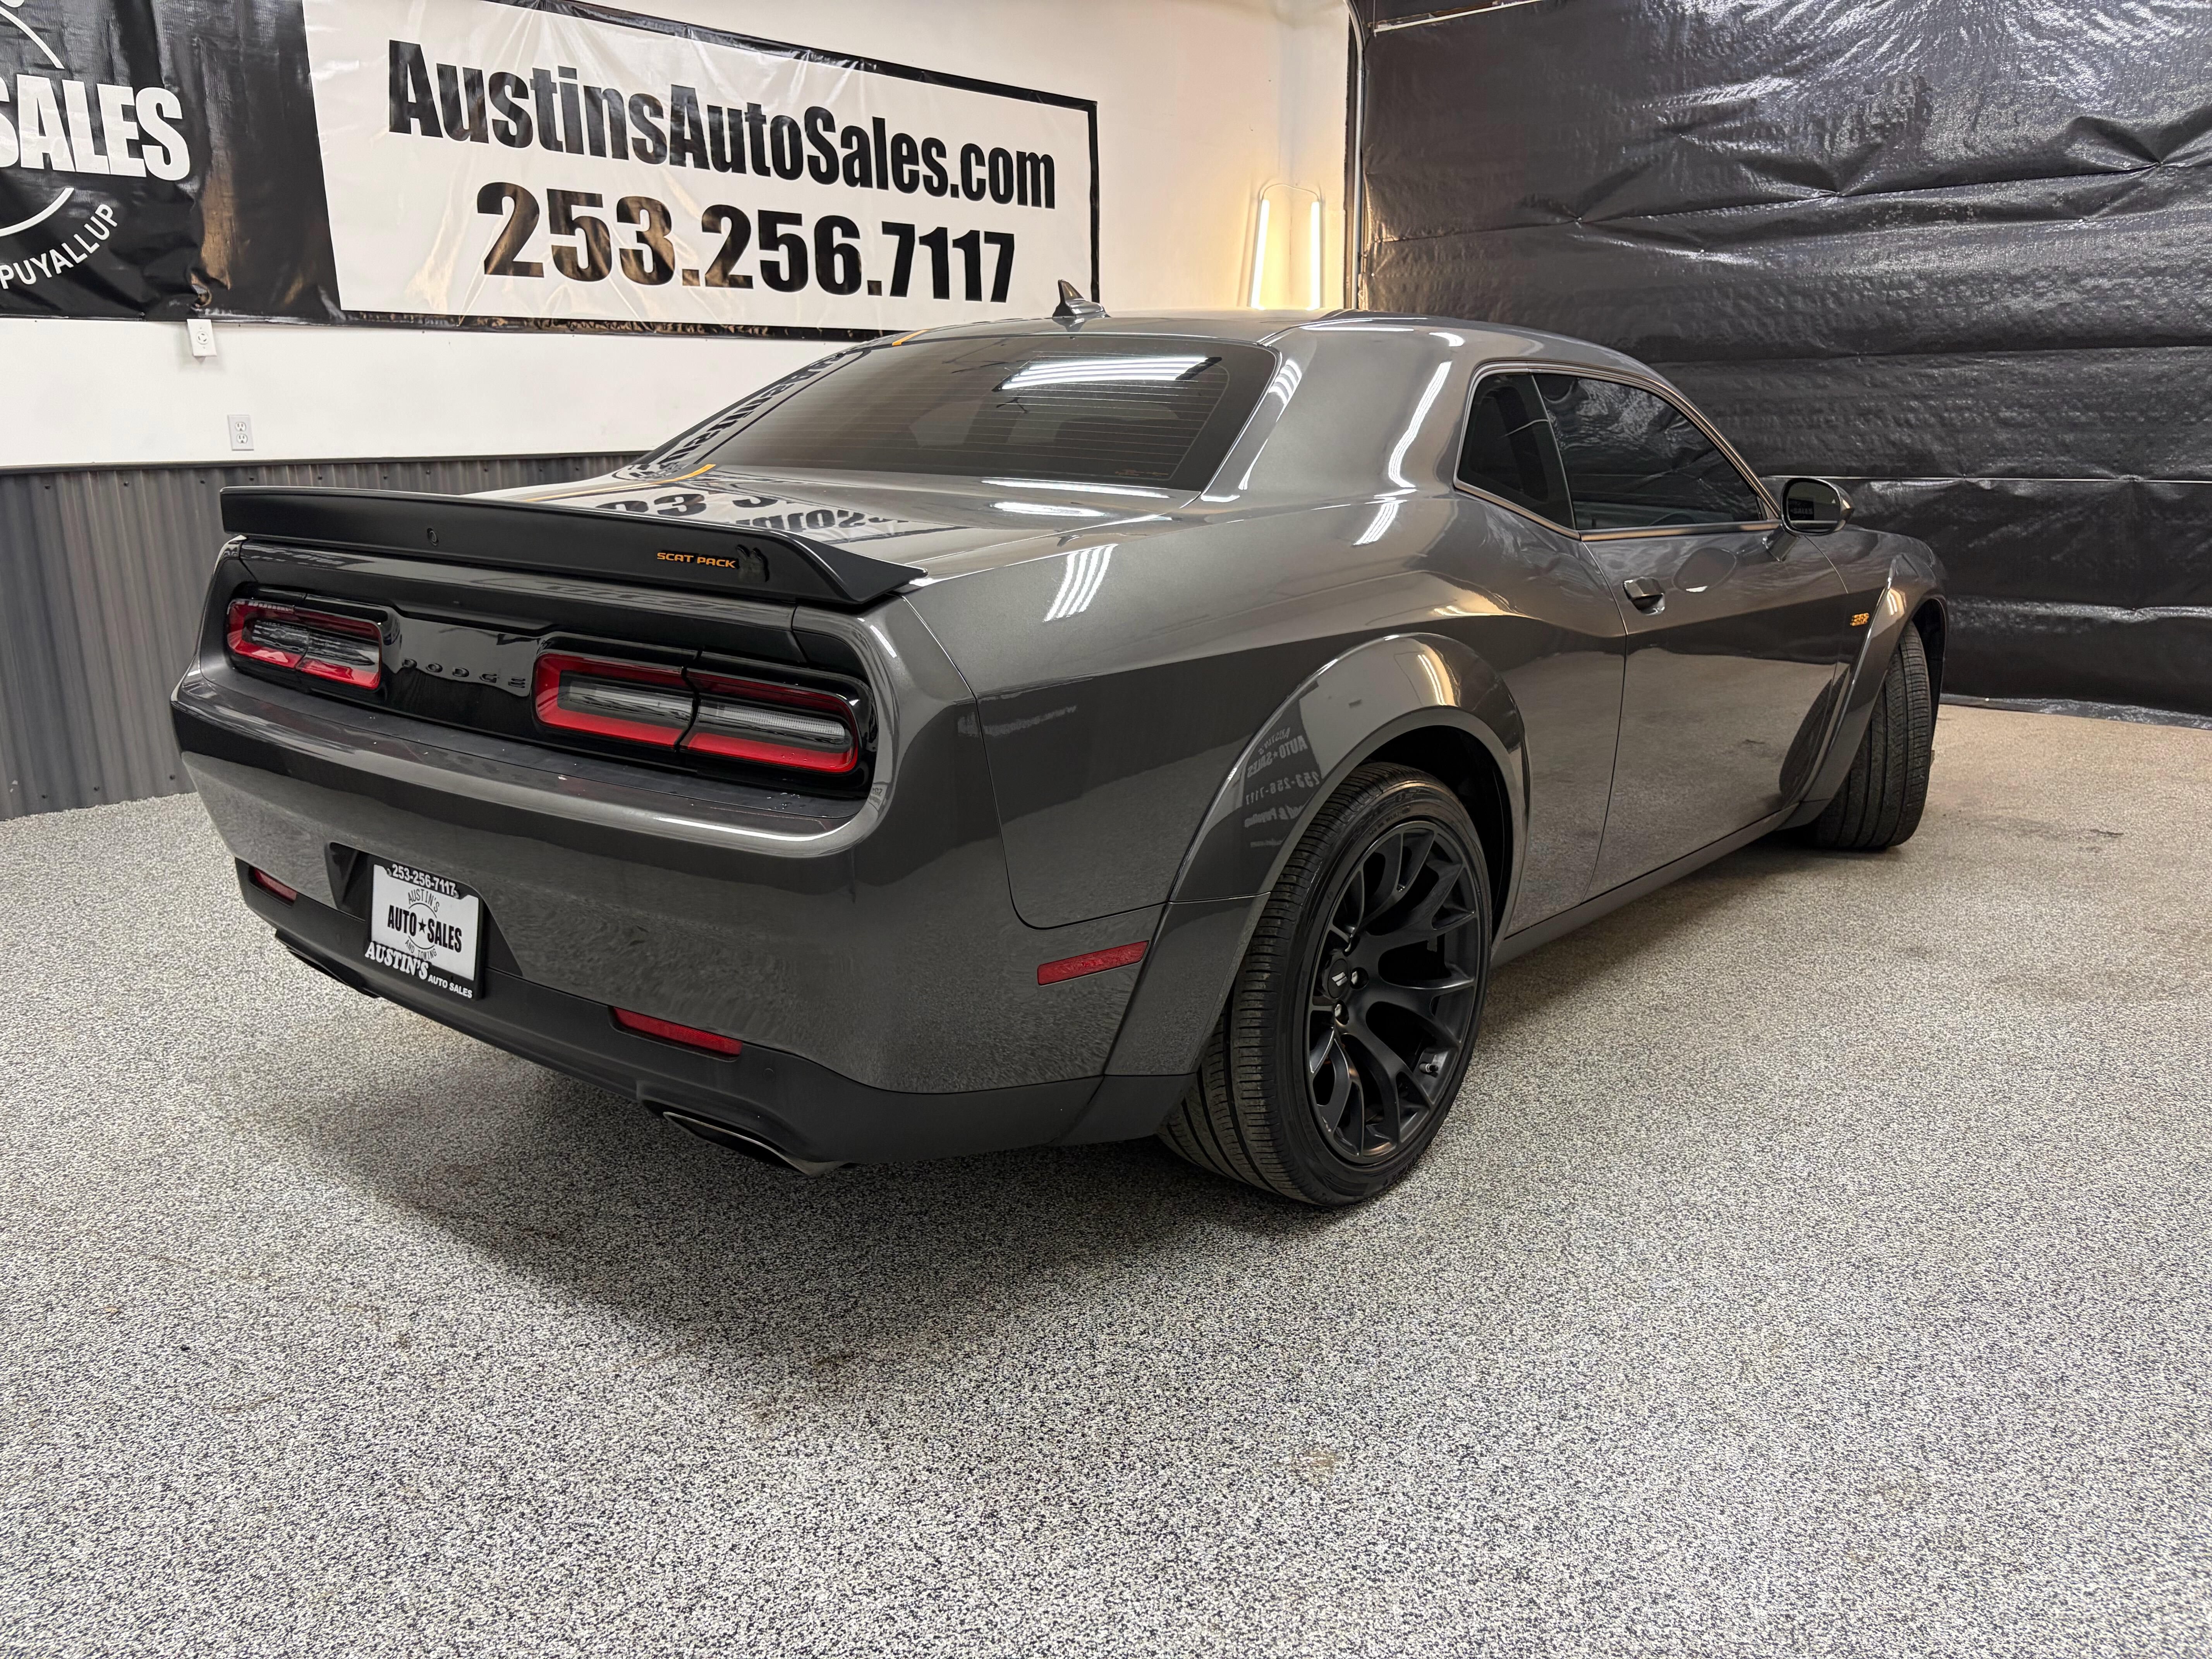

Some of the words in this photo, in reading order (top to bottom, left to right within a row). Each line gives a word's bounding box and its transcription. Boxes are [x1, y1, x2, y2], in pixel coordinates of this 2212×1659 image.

[389, 39, 1055, 209] AustinsAutoSales.com
[0, 204, 117, 289] PUYALLUP
[477, 182, 1015, 303] 253.256.7117
[657, 552, 694, 563] SCAT
[697, 556, 736, 568] PACK
[402, 658, 526, 688] DODGE
[392, 863, 456, 896] 253-256-7117
[408, 889, 440, 913] AUSTIN'S
[387, 905, 417, 936] AUTO
[428, 918, 462, 953] SALES
[405, 939, 415, 953] AND
[417, 948, 437, 960] TOWING
[364, 941, 429, 980] AUSTIN'S
[428, 974, 448, 989] AUTO
[449, 982, 472, 999] SALES
